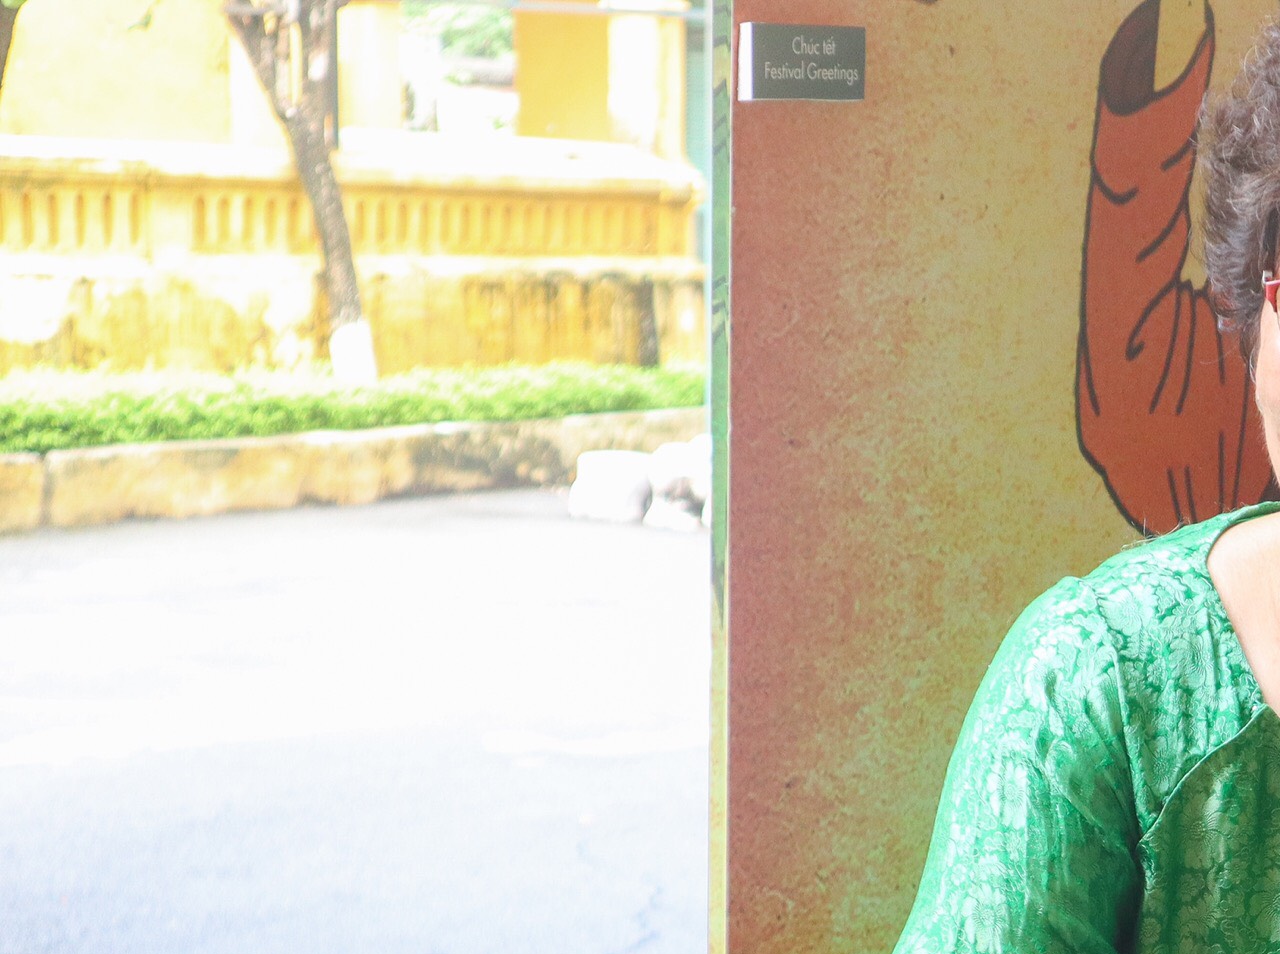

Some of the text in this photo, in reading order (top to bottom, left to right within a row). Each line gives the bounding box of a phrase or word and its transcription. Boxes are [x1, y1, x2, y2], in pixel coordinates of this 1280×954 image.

[792, 35, 836, 55] Chúc tết
[764, 61, 859, 86] Festival Greetings
